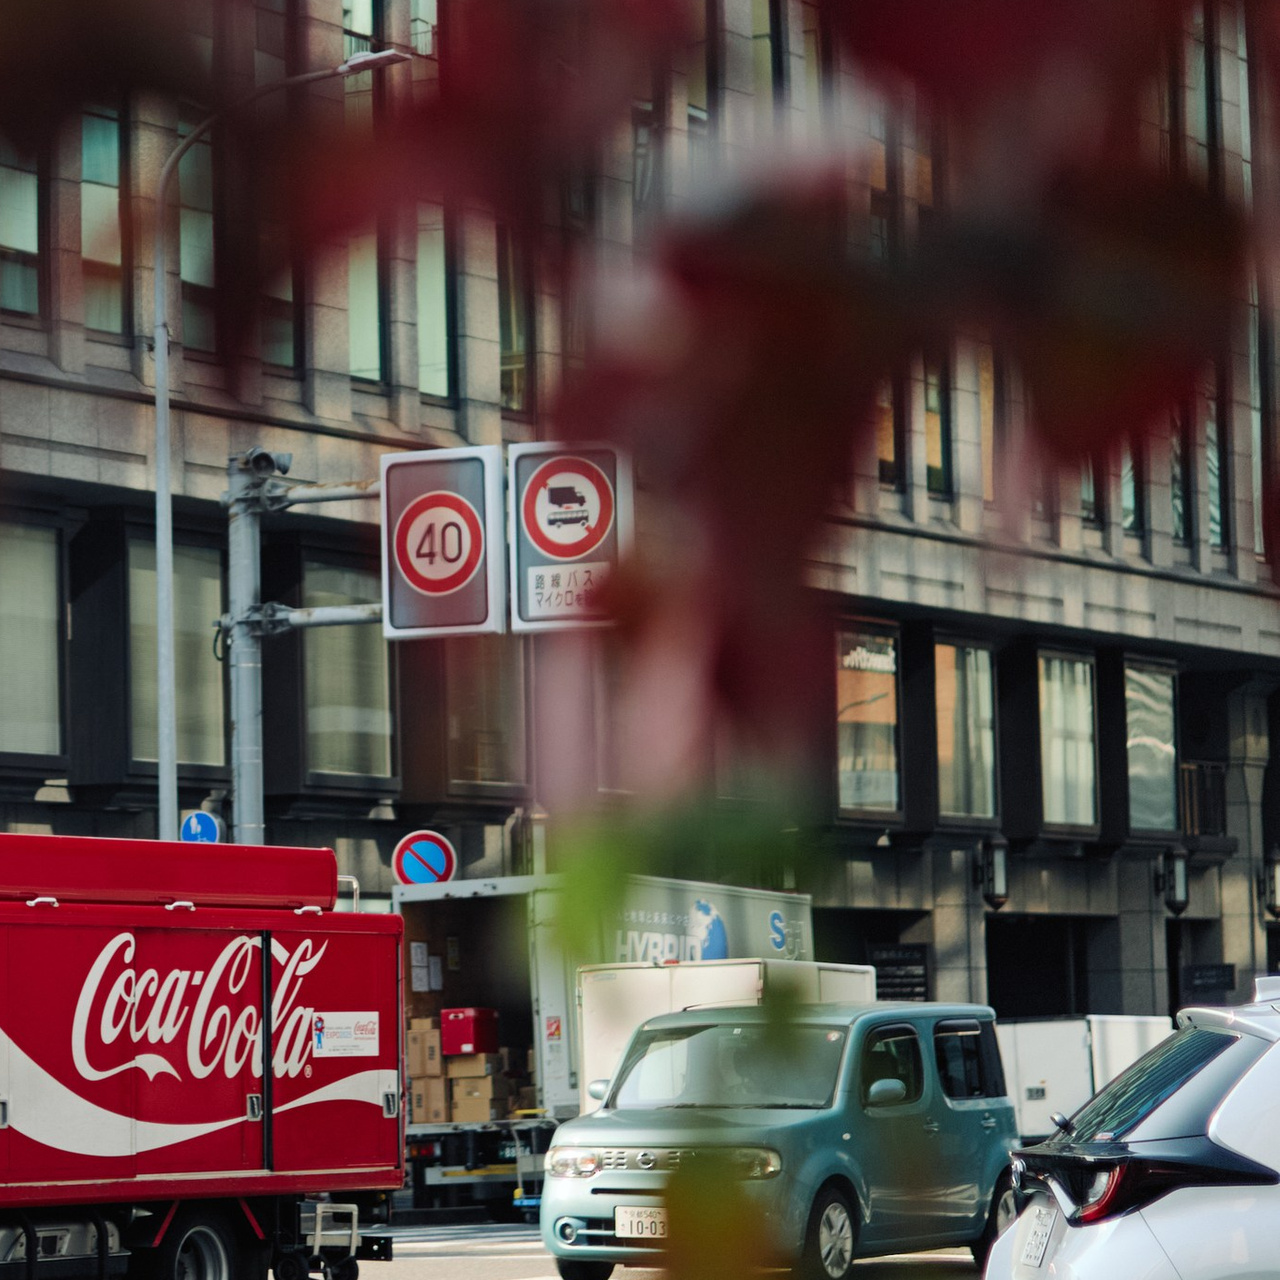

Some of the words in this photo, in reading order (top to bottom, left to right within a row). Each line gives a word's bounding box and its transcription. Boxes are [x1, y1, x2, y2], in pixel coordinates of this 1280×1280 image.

[415, 521, 463, 565] 40
[71, 932, 329, 1082] Coca-Cola
[630, 1220, 666, 1236] 10-03
